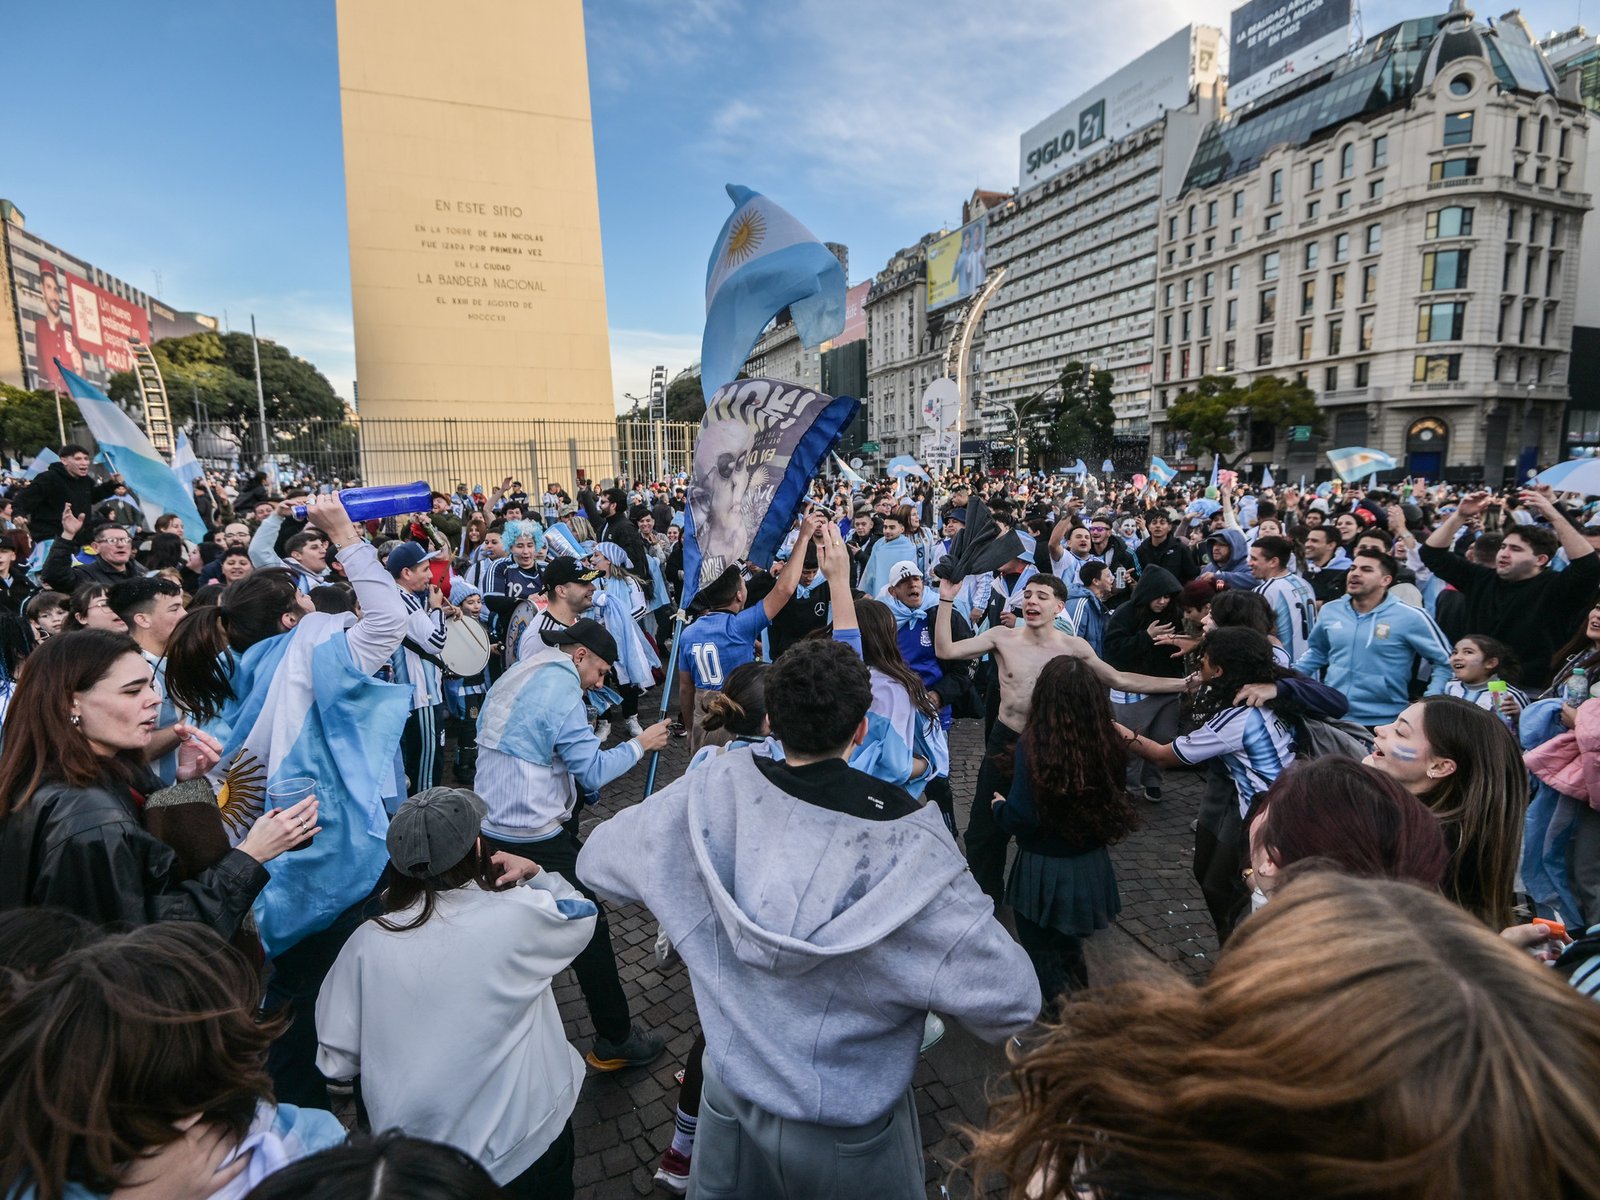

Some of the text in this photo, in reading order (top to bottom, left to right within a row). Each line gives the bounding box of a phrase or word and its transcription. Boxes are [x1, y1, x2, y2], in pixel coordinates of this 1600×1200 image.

[1235, 30, 1247, 44] LA
[1247, 7, 1287, 37] REALIDAD
[1247, 0, 1324, 48] SE EXPLICA MEJOR
[1268, 32, 1280, 48] EN
[1026, 113, 1100, 174] SIGLO 21
[435, 199, 523, 218] EN ESTE SITIO
[415, 224, 544, 242] EN LA TORRE DE SAN NICOLAS
[421, 240, 543, 257] FUE IZADA POR PRIMERA VEZ
[483, 262, 511, 272] CIUDAD
[417, 273, 547, 292] LA BANDERA NACIONAL
[436, 296, 447, 304] EL
[472, 298, 482, 306] DE
[487, 299, 519, 309] AGOSTO
[523, 301, 533, 309] DE
[507, 582, 523, 598] 19
[691, 641, 724, 686] 10
